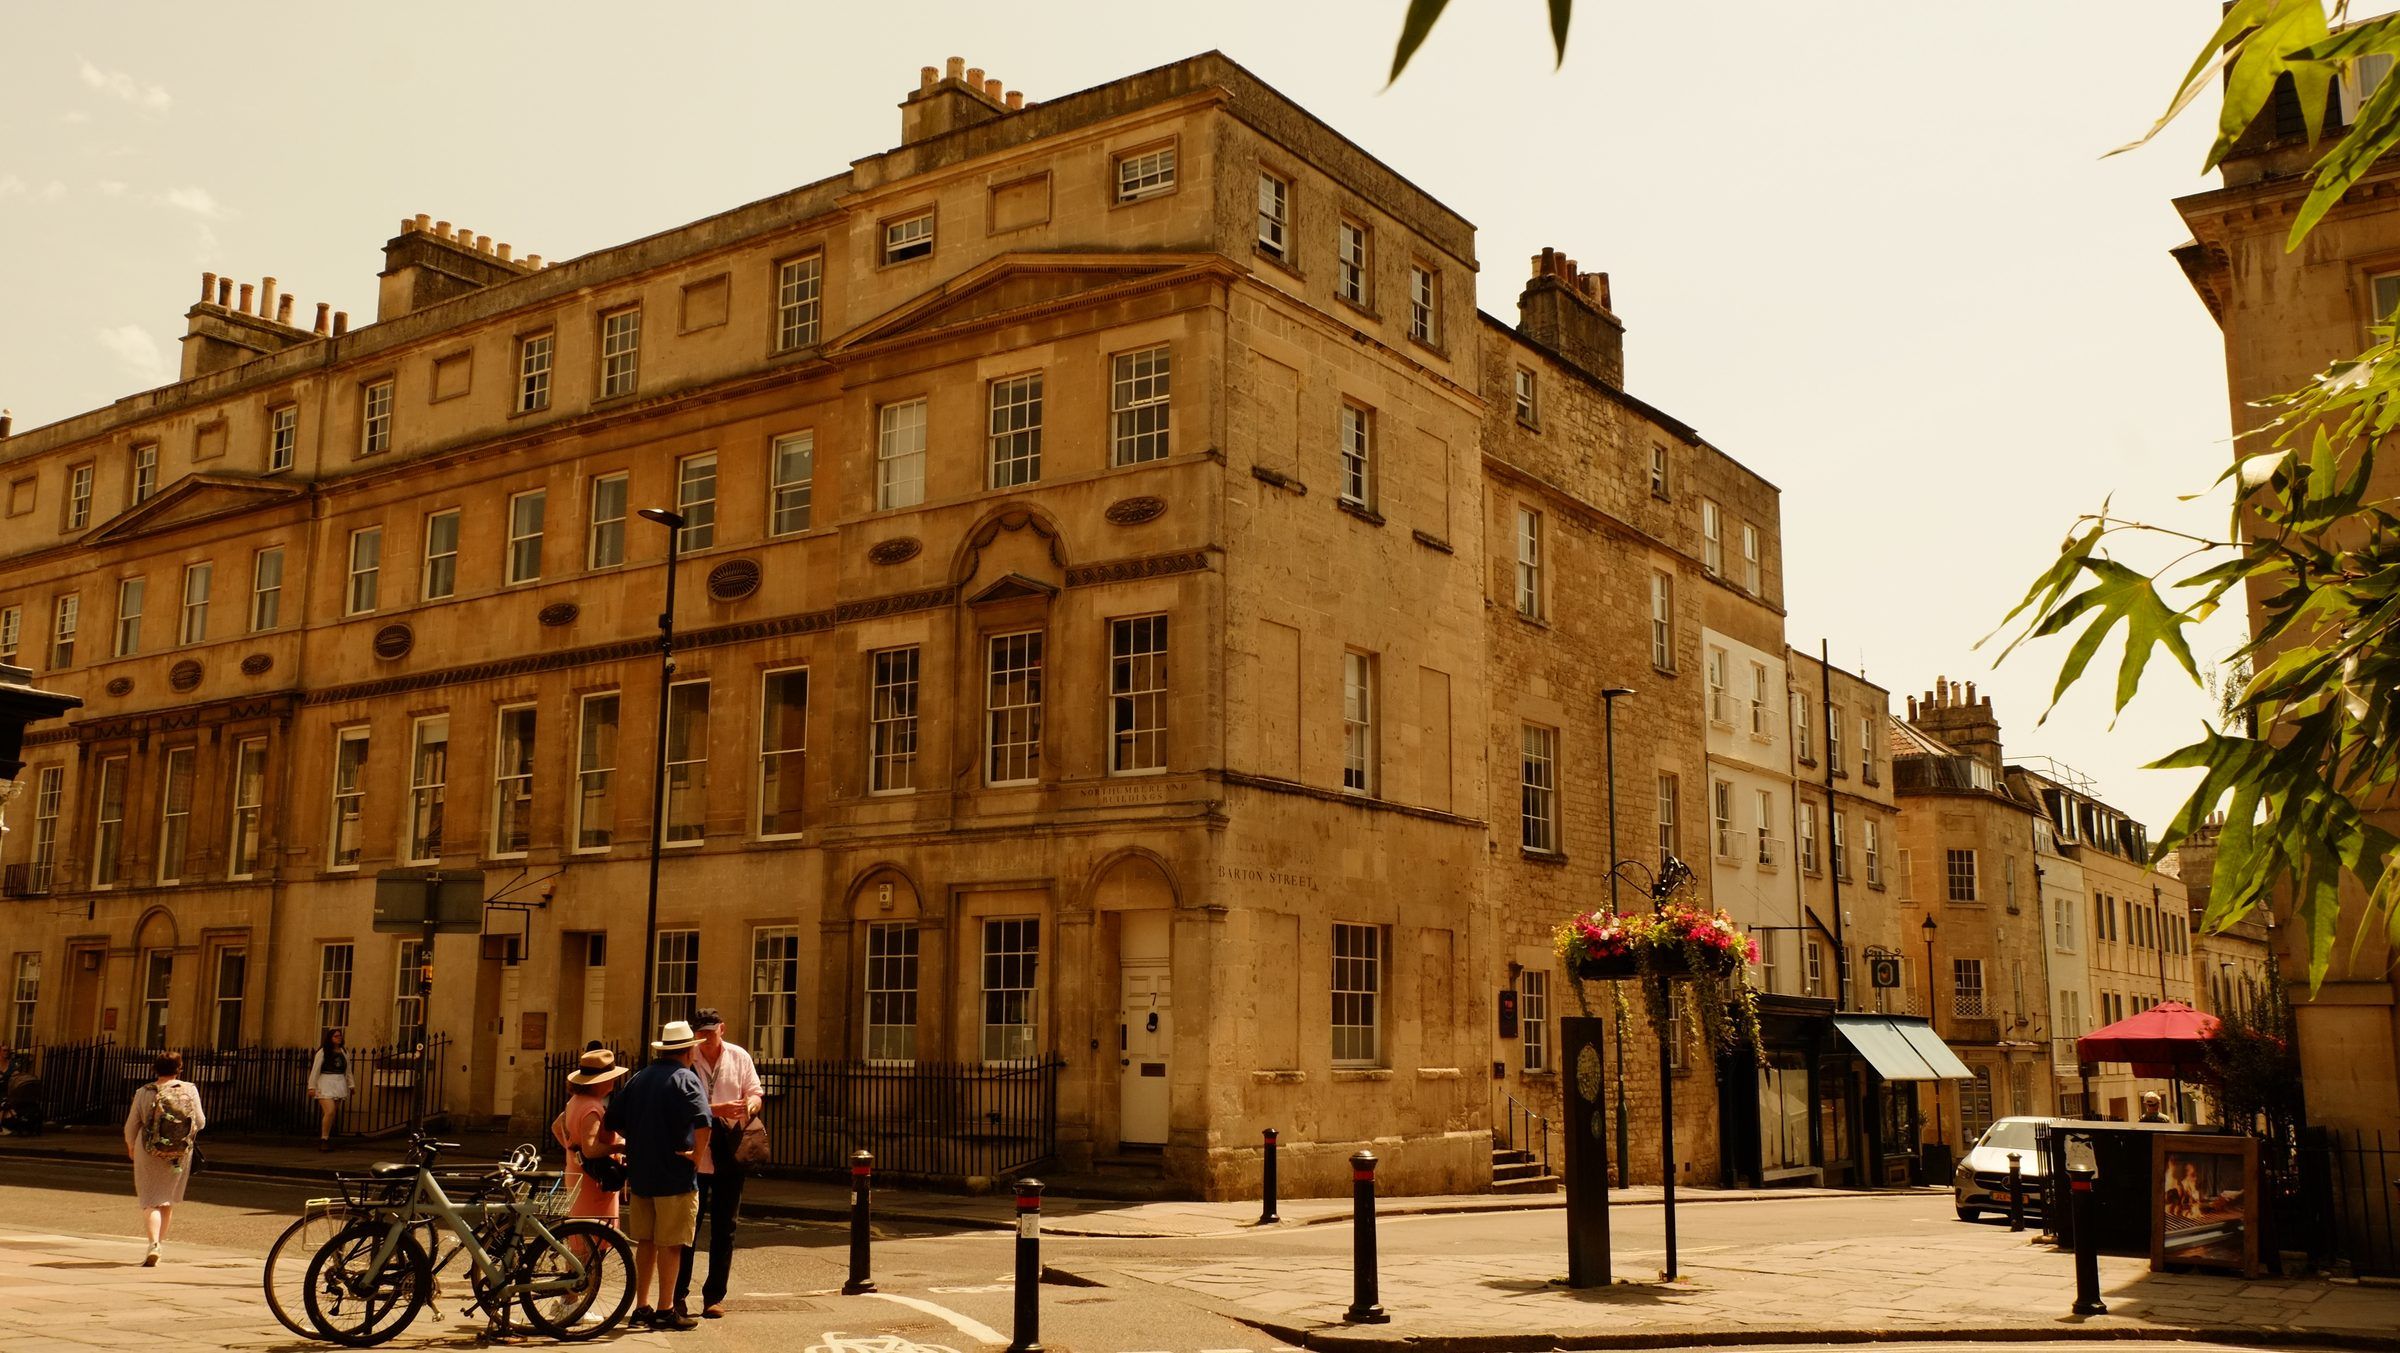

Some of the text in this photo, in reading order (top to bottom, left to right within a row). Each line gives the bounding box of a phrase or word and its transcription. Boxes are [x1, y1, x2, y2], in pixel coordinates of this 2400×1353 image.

[1080, 783, 1188, 797] NORTHUMBERLAND
[1102, 793, 1163, 804] BUILDINGS
[1218, 865, 1313, 889] BARTON STREET
[1150, 992, 1157, 1007] 7
